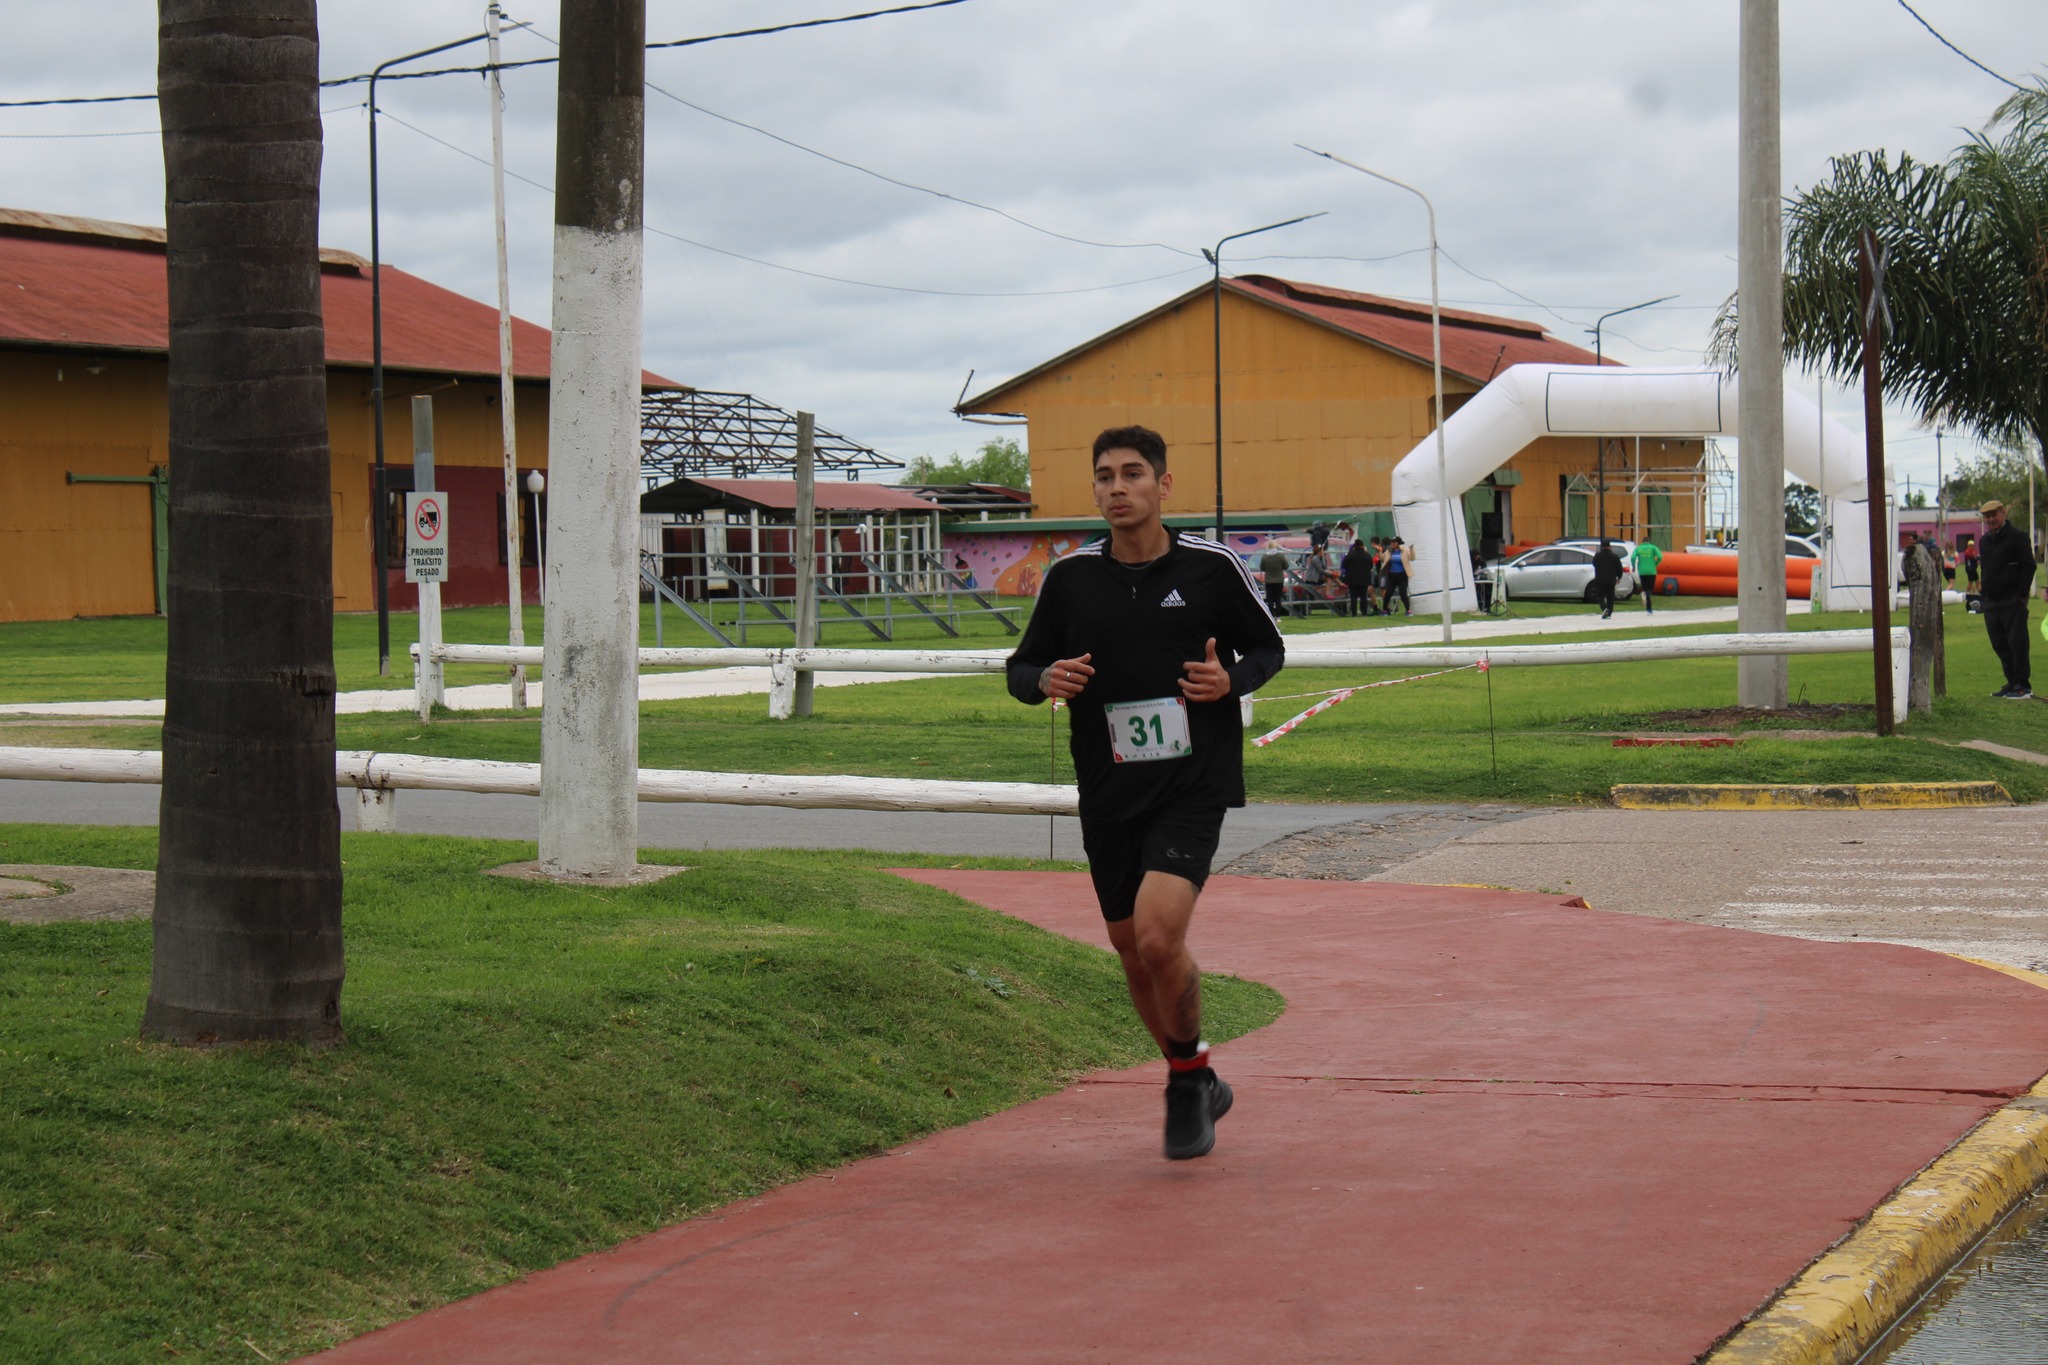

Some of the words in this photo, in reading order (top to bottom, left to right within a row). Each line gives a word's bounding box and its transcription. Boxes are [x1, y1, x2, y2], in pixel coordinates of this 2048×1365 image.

[410, 547, 444, 555] PROHIBIDO
[415, 568, 439, 576] PESADO
[1128, 713, 1164, 747] 31
